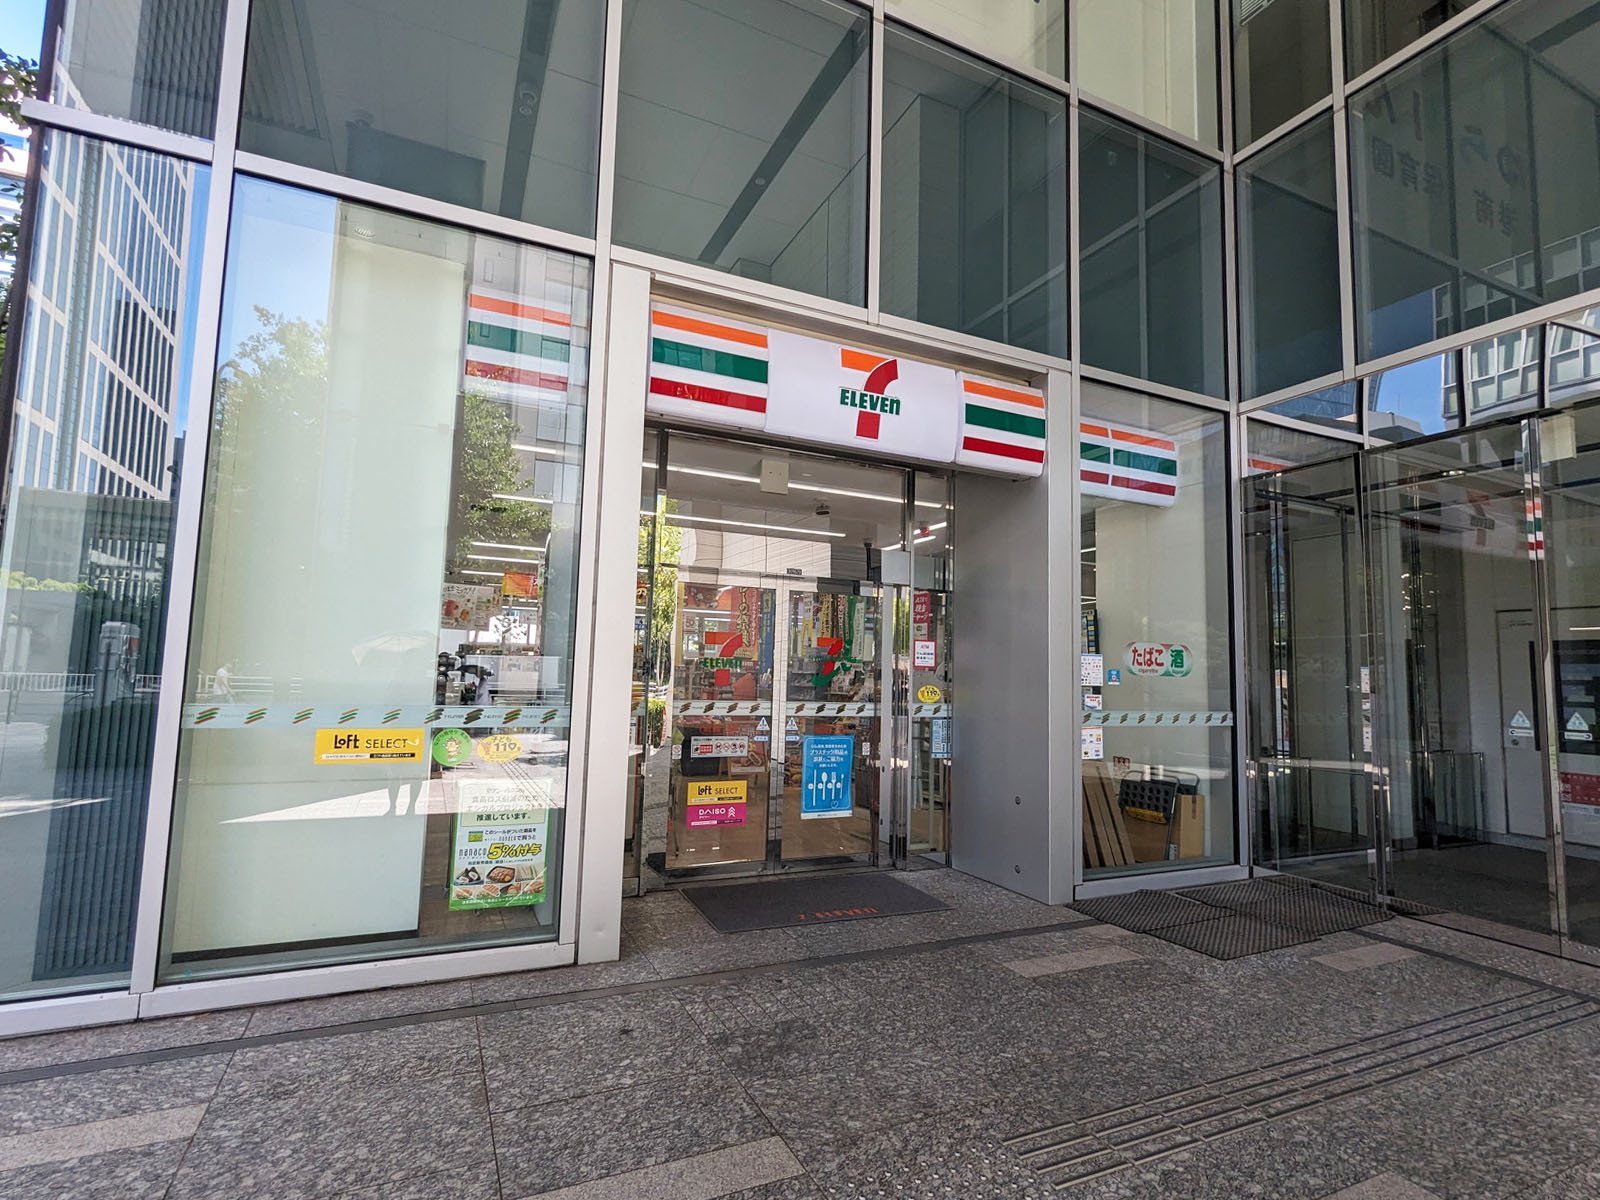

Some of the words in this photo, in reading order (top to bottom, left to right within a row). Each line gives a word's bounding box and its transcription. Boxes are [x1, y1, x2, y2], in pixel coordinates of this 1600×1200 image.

[1131, 646, 1164, 666] たばこ
[1170, 648, 1184, 668] 酒
[365, 738, 408, 748] SELECT
[487, 843, 542, 860] 5%付与
